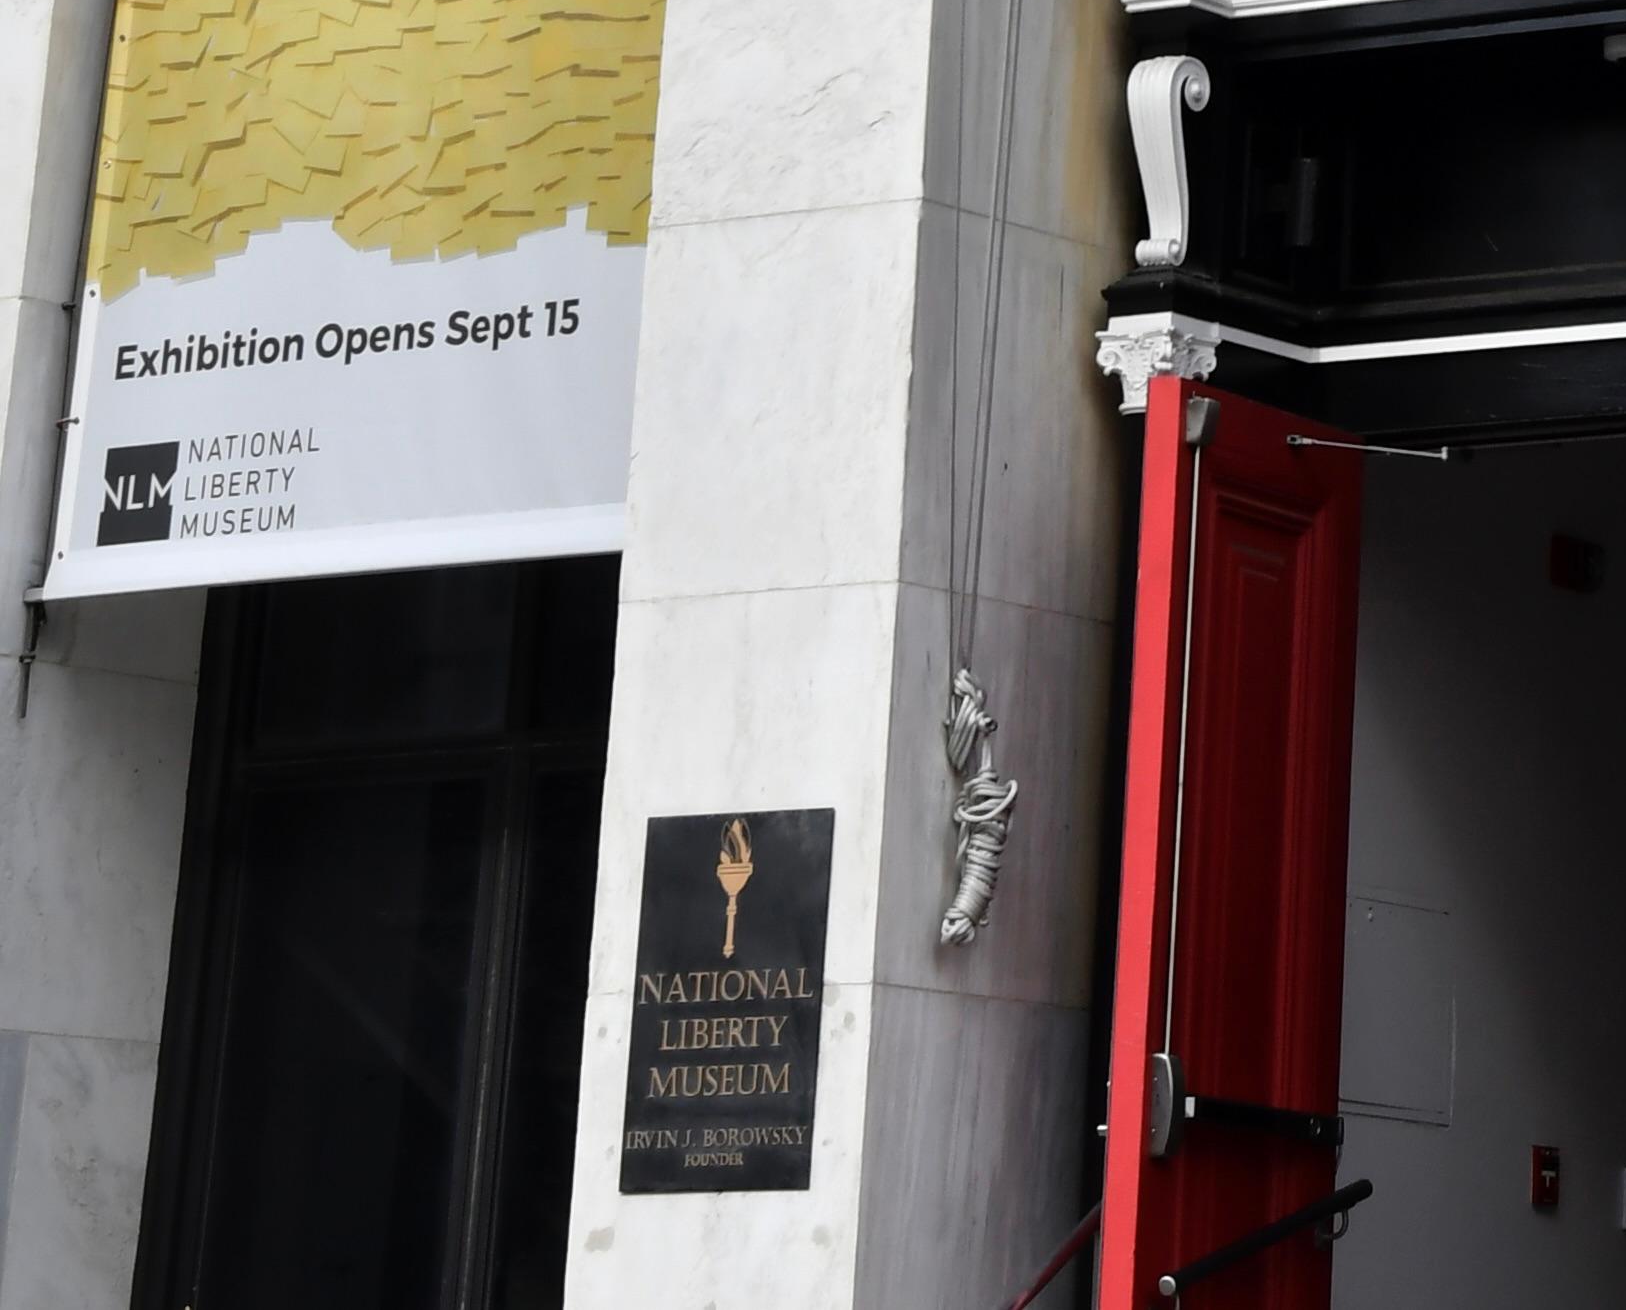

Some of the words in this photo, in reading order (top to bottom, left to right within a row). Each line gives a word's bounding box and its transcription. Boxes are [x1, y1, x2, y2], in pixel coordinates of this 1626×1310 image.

[114, 327, 303, 381] Exhibition
[315, 317, 435, 364] Opens
[445, 304, 534, 351] Sept
[545, 299, 580, 337] 15
[188, 427, 320, 464] NATIONAL
[102, 471, 177, 513] NLM
[184, 467, 296, 502] LIBERTY
[180, 504, 296, 539] MUSEUM
[639, 968, 814, 1004] NATIONAL
[659, 1016, 787, 1051] LIBERTY
[648, 1063, 791, 1098] MUSEUM
[626, 1130, 678, 1149] IRVIN
[683, 1129, 696, 1148] J.
[703, 1126, 808, 1147] BOROWSKY
[684, 1153, 744, 1168] FOUNDER
